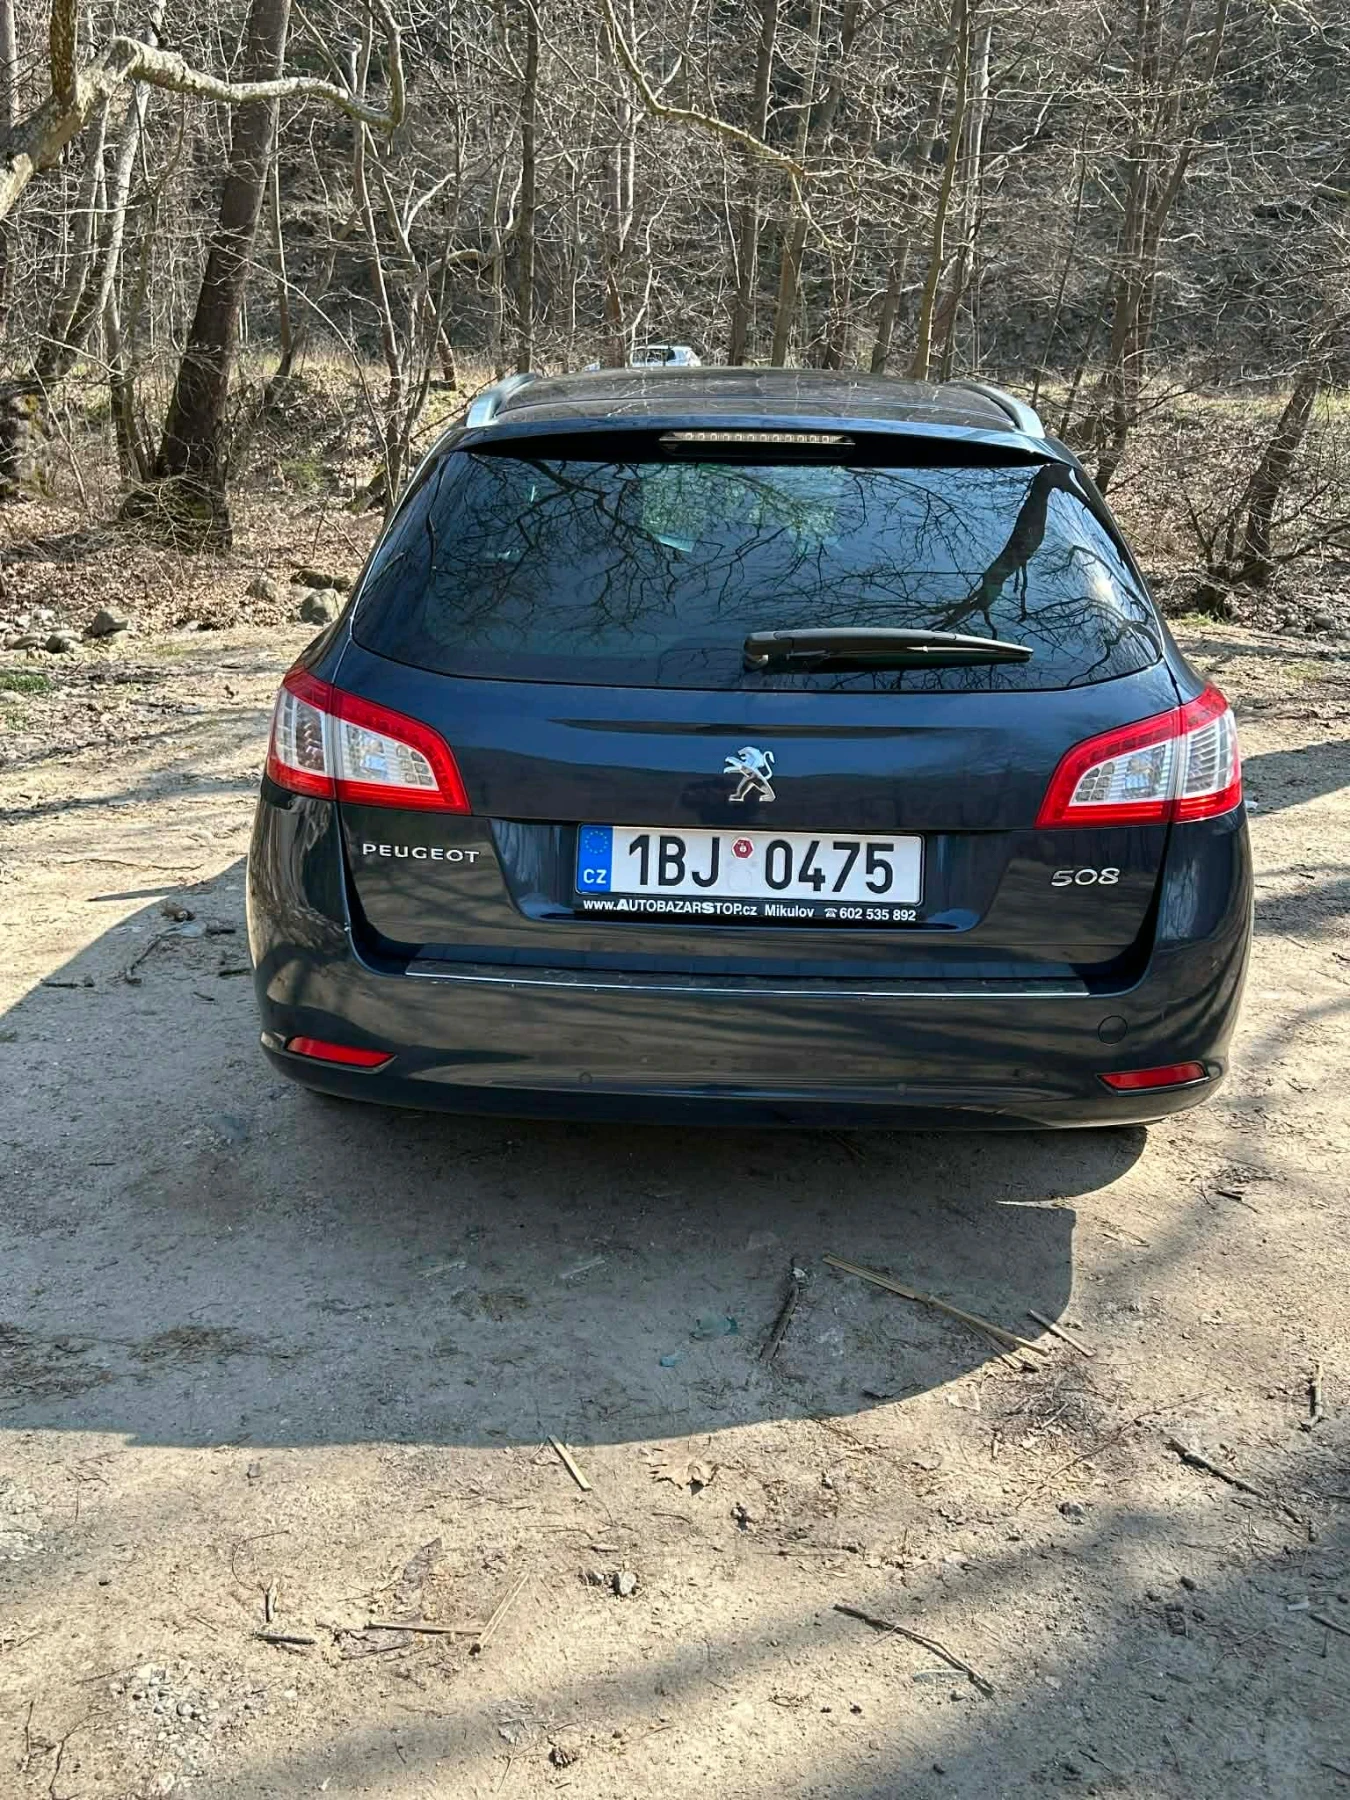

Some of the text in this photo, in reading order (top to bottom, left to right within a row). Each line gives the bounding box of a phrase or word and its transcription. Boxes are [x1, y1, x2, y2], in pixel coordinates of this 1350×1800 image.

[362, 843, 480, 863] PEUGEOT
[629, 834, 895, 894] 1BJ 0475
[583, 868, 607, 885] CZ
[1051, 867, 1120, 887] 508
[583, 898, 916, 922] www.AUTOBAZARSTOP.cz Mikulov 602 535 892
